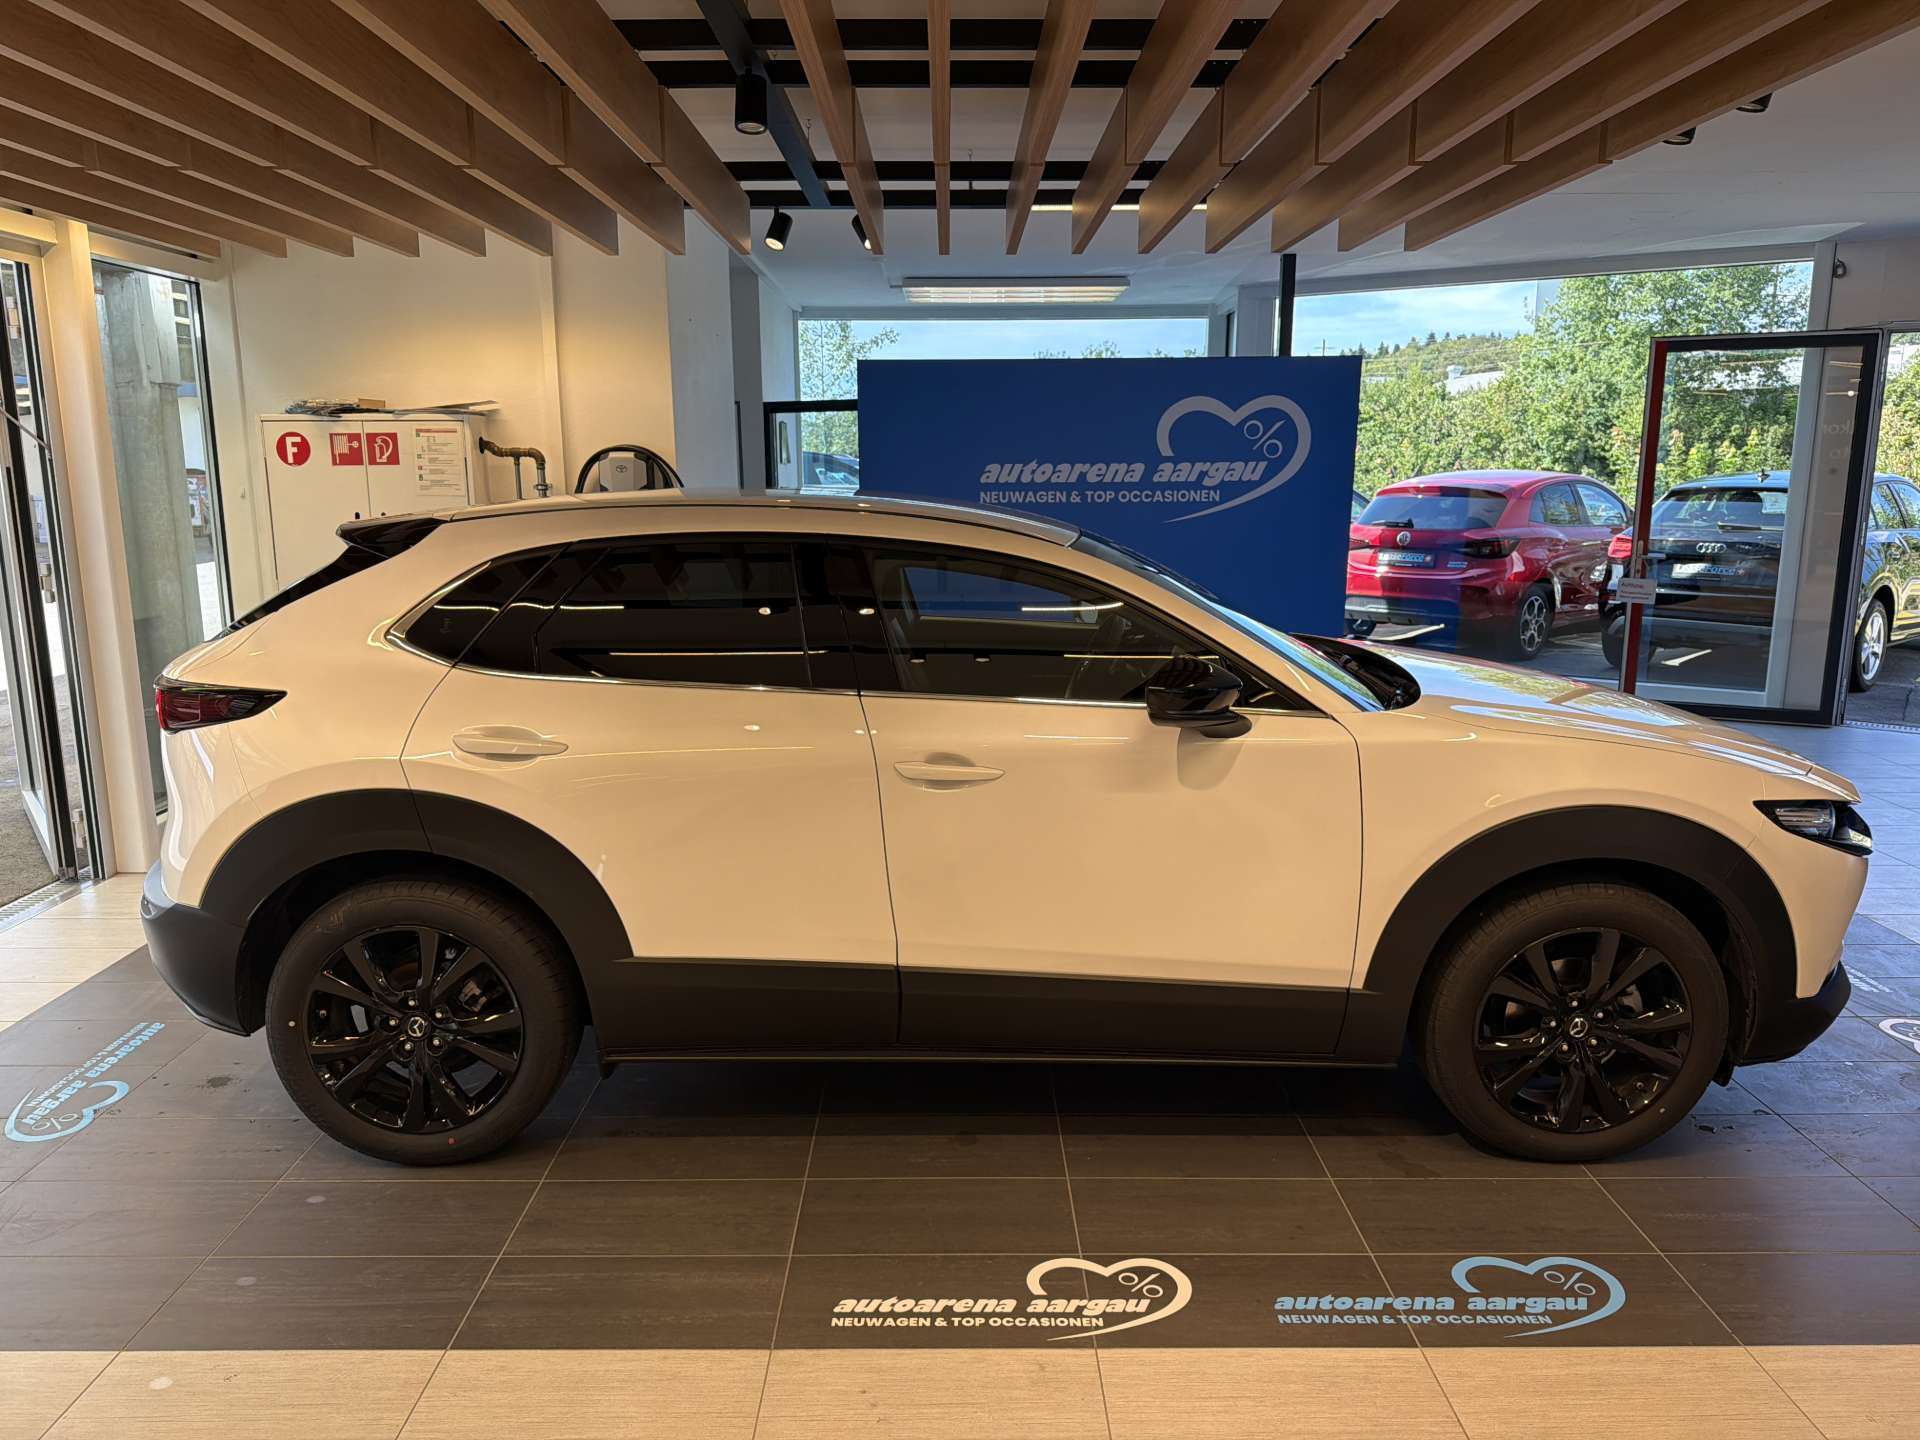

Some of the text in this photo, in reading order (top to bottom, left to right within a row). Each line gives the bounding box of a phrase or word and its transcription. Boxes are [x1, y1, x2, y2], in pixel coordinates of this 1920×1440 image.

[284, 436, 302, 464] F
[979, 458, 1268, 487] autoarena aargau
[980, 489, 1220, 504] NEUWAGEN & TOP OCCASIONEN
[832, 1295, 1152, 1316] autoarena aargau
[1273, 1294, 1589, 1313] autoarena aargau
[831, 1317, 1105, 1328] NEUWAGEN & TOP OCCASIONEN
[1277, 1314, 1553, 1325] NEUWAGEN & TOP OCCASIONEN
